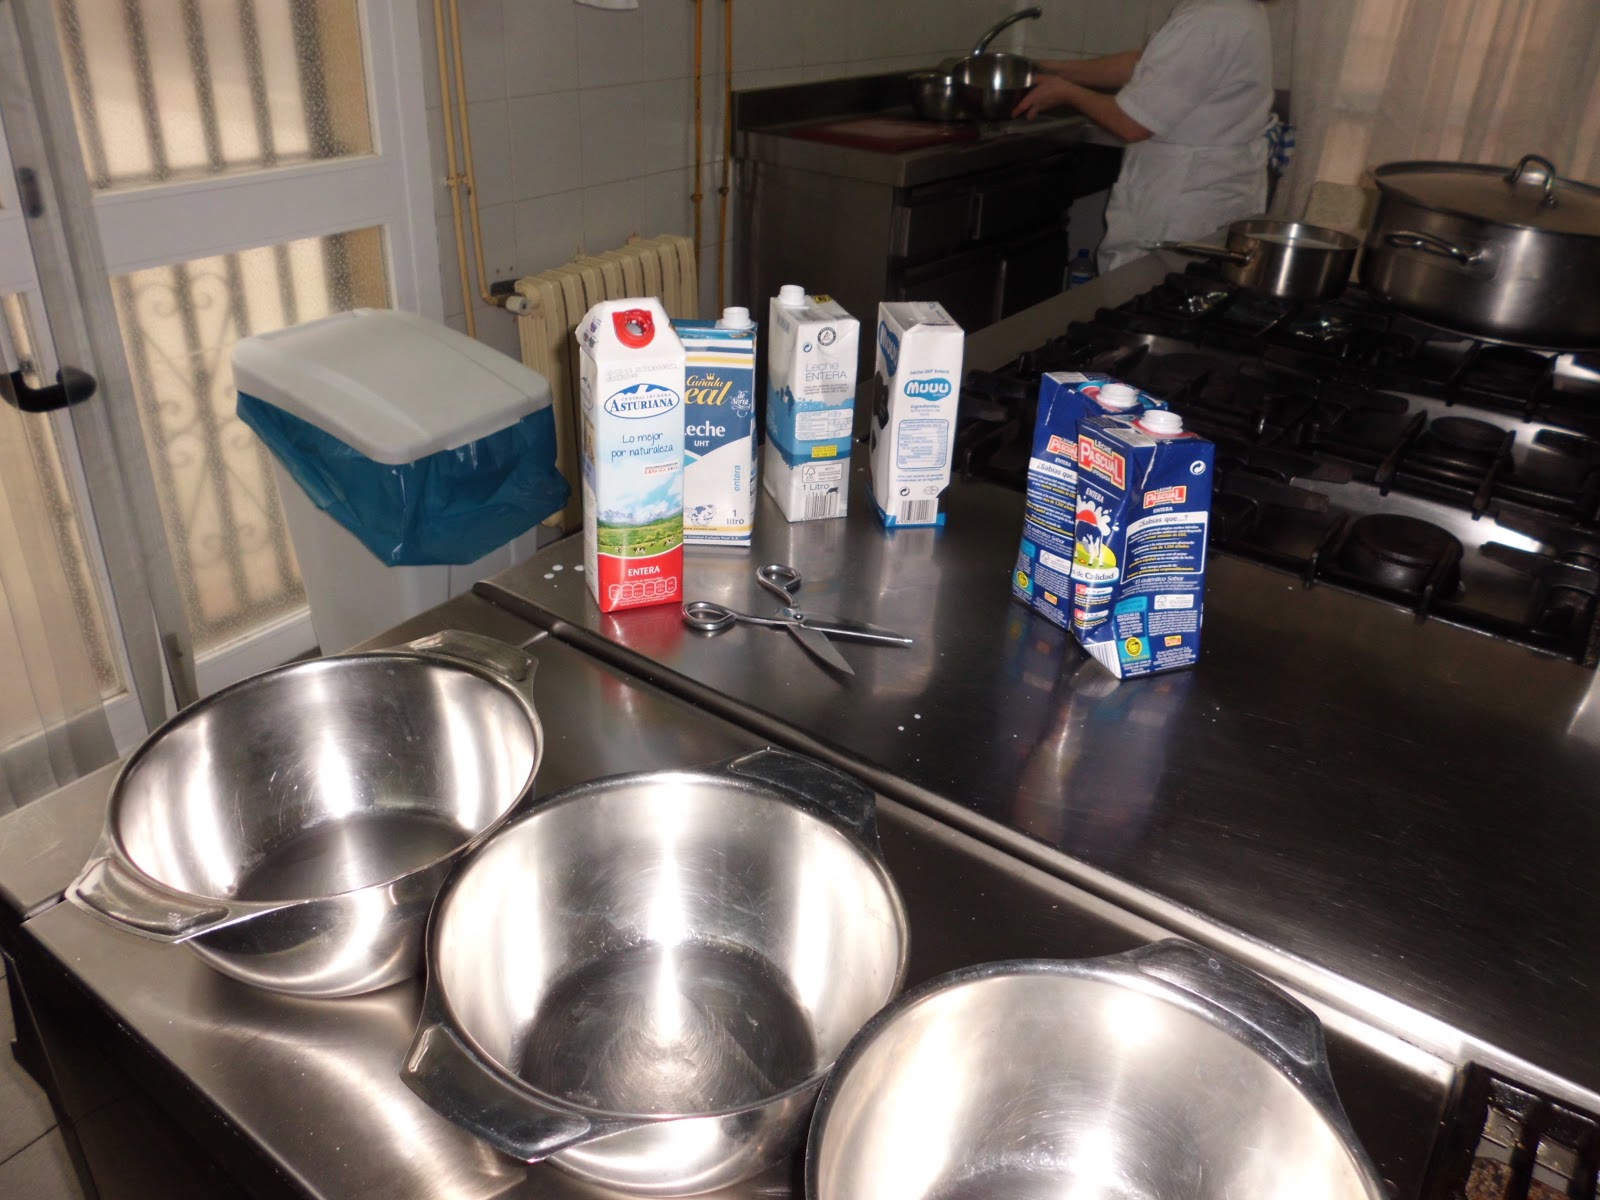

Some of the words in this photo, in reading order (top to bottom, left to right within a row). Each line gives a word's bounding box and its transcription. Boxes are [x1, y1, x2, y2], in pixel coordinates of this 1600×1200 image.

[805, 361, 840, 373] Leche
[686, 374, 725, 387] Cañada
[805, 370, 848, 382] ENTERA
[685, 381, 733, 406] eal
[906, 381, 949, 395] Muuu
[609, 398, 674, 413] ASTURIANA
[684, 420, 726, 437] eche
[622, 434, 635, 444] Lo
[637, 432, 664, 446] mejor
[611, 449, 627, 462] por
[629, 444, 674, 457] naturaleza
[1094, 439, 1113, 454] LECHE
[1080, 441, 1122, 484] PASCUAL
[733, 464, 741, 492] entera
[809, 483, 830, 491] Litro
[1085, 487, 1104, 504] ENTERA
[1145, 489, 1183, 506] PASCUAL
[732, 509, 737, 517] 1
[1153, 506, 1174, 514] ENTERA
[627, 565, 661, 577] ENTERA
[1085, 572, 1115, 581] Calidad
